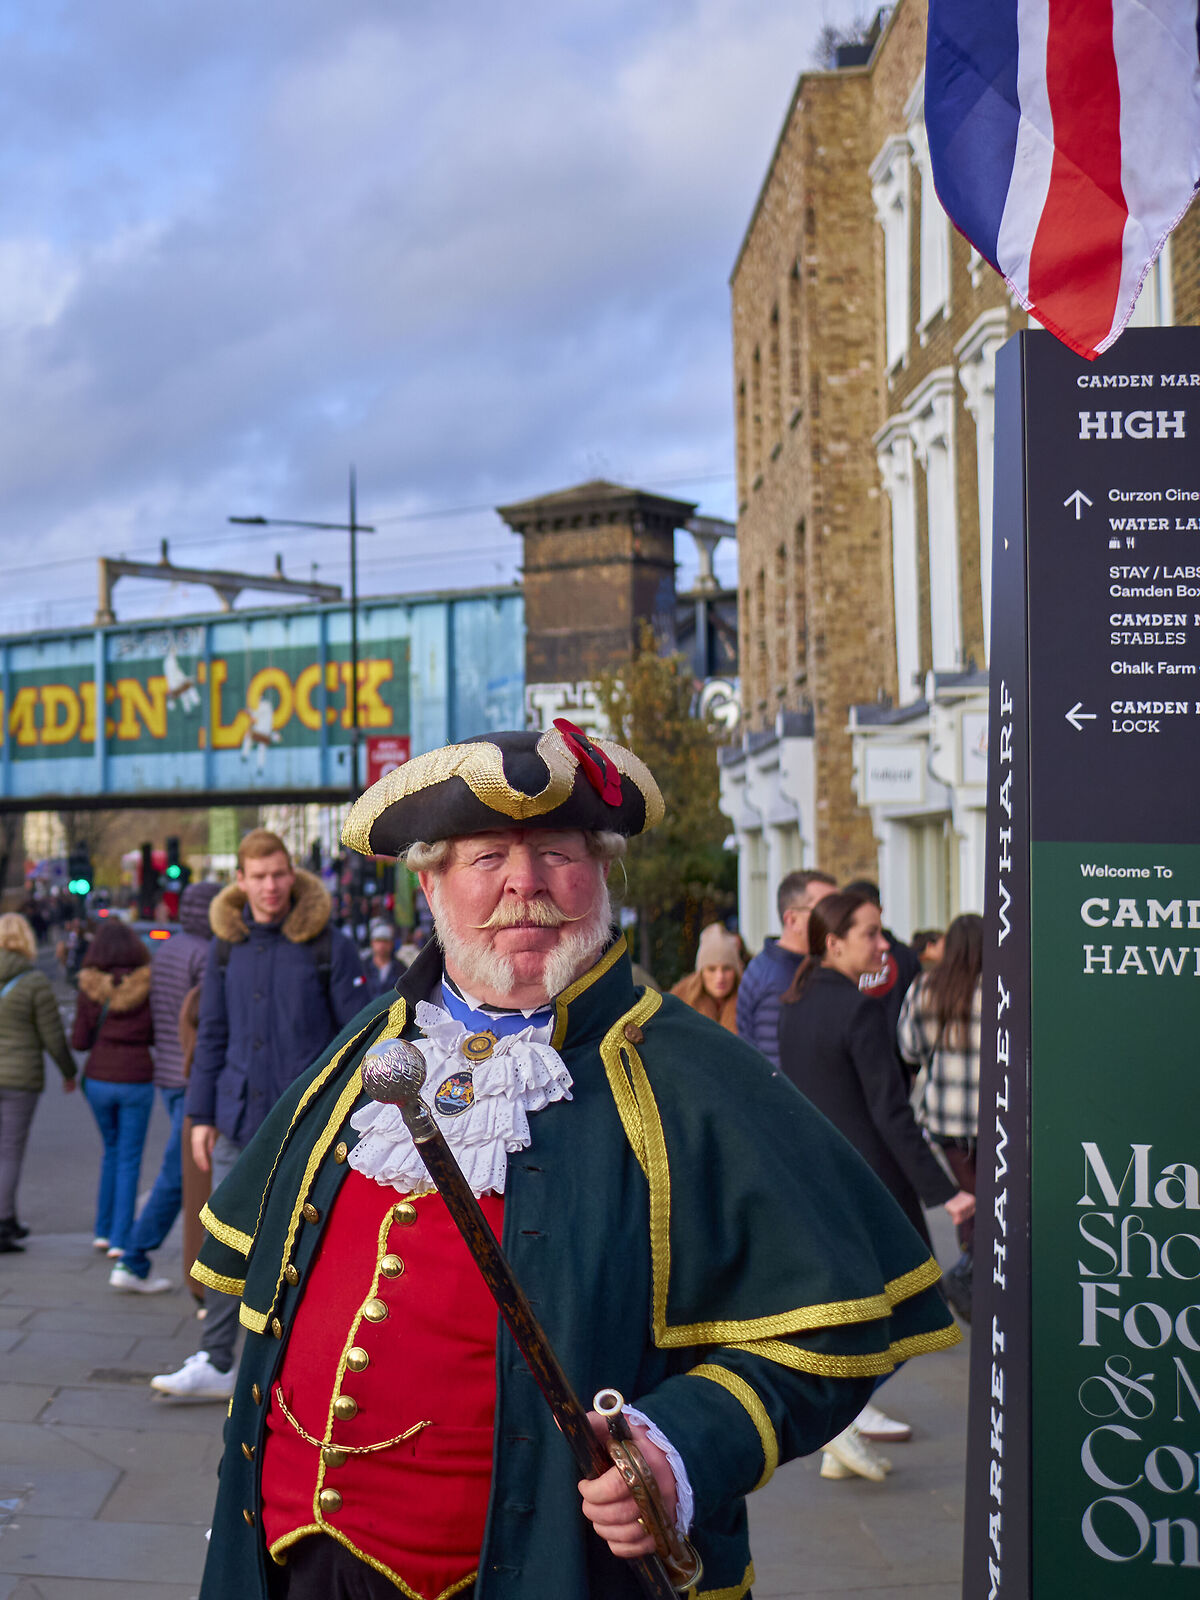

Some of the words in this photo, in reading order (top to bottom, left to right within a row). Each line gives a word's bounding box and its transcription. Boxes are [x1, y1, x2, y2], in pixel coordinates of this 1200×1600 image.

[1077, 375, 1154, 388] CAMDEN
[1160, 374, 1200, 387] MAR
[1078, 410, 1186, 439] HIGH
[1108, 488, 1162, 502] Curzon
[1165, 488, 1200, 501] Cine
[1108, 518, 1169, 531] WATER
[1175, 518, 1200, 531] LA
[1109, 566, 1150, 579] STAY
[1153, 566, 1160, 580] /
[1109, 584, 1173, 597] Camden
[1109, 613, 1187, 626] CAMDEN
[1110, 632, 1186, 645] STABLES
[1110, 661, 1154, 674] Chalk
[1157, 661, 1196, 674] Farm
[197, 659, 394, 750] LOCK
[1110, 701, 1188, 714] CAMDEN
[1111, 720, 1160, 733] LOCK
[998, 680, 1013, 947] WHARF
[1080, 864, 1151, 878] Welcome
[1153, 866, 1173, 879] To
[993, 975, 1010, 1291] HAWLEY
[1076, 1141, 1200, 1210] Ma
[1078, 1212, 1200, 1281] Sho
[1078, 1354, 1155, 1420] &
[988, 1314, 1005, 1600] MARKET
[1080, 1424, 1200, 1494] Co
[1081, 1495, 1200, 1568] On
